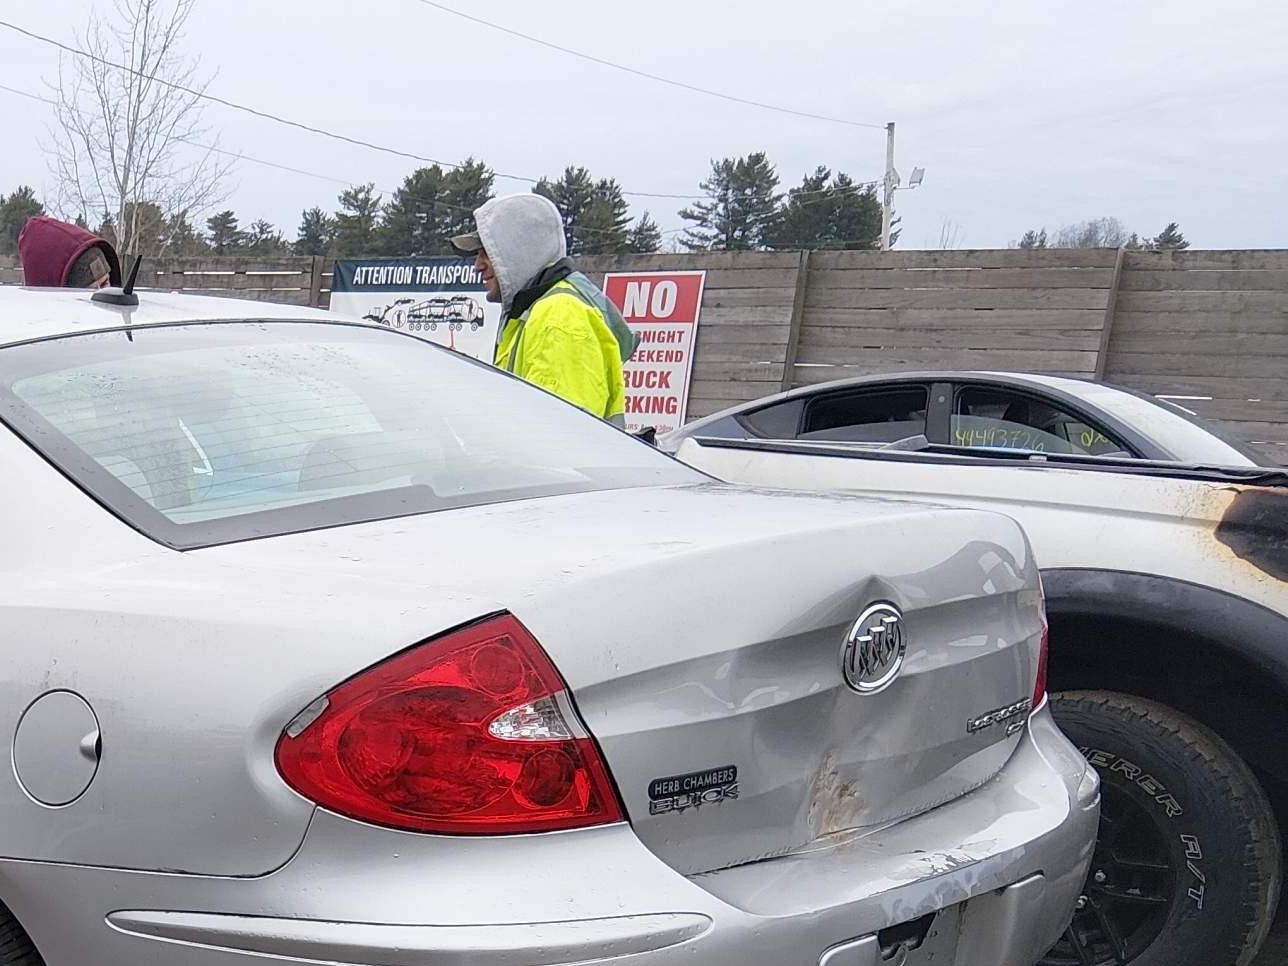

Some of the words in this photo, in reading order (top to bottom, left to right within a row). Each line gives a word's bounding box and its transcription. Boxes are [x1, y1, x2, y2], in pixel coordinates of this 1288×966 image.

[353, 266, 413, 285] ATTENTION
[415, 265, 487, 284] TRANSPORT
[623, 281, 678, 319] NO
[631, 350, 684, 363] EEKEND
[623, 370, 672, 389] RUCK
[624, 396, 678, 415] RKING
[654, 781, 680, 795] HERB
[683, 769, 734, 790] CHAMBERS
[649, 782, 741, 815] BUICK
[1180, 834, 1206, 910] A/T
